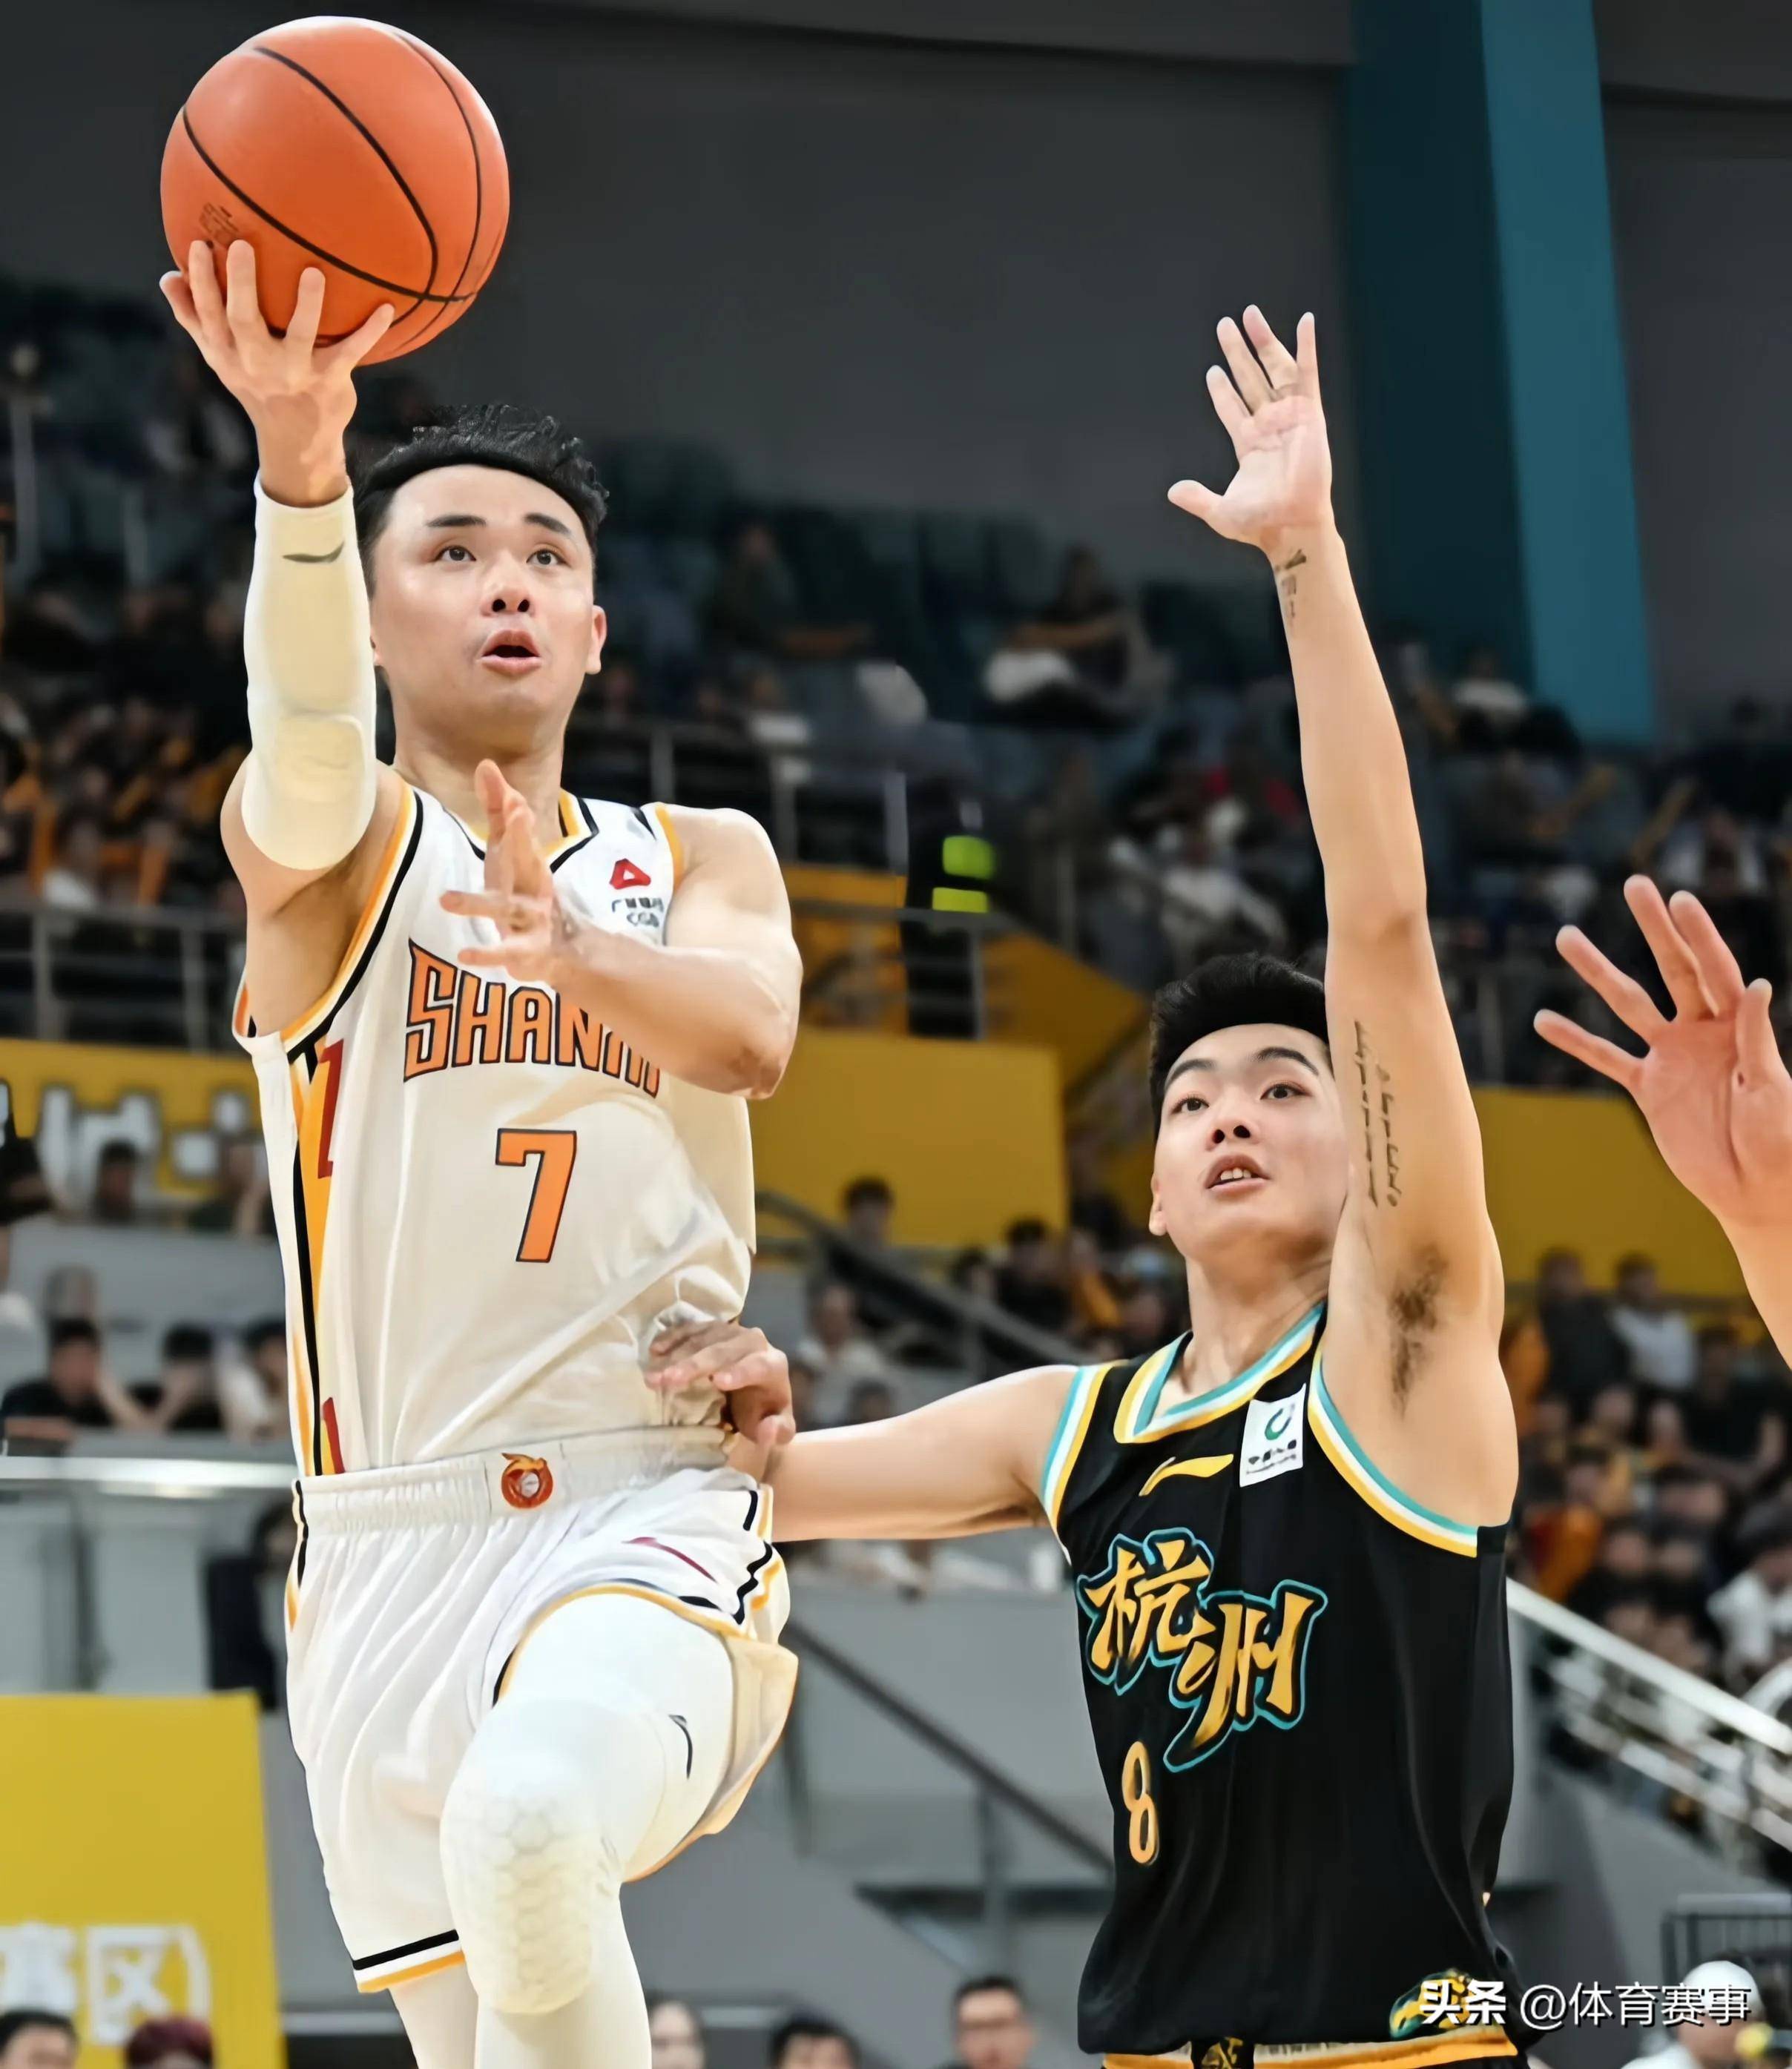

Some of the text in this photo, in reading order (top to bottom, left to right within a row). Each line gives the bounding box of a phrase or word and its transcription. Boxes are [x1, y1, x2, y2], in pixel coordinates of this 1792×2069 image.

[495, 1128, 577, 1263] 7
[1075, 1527, 1328, 1772] 杭州
[1121, 1740, 1159, 1865] 8
